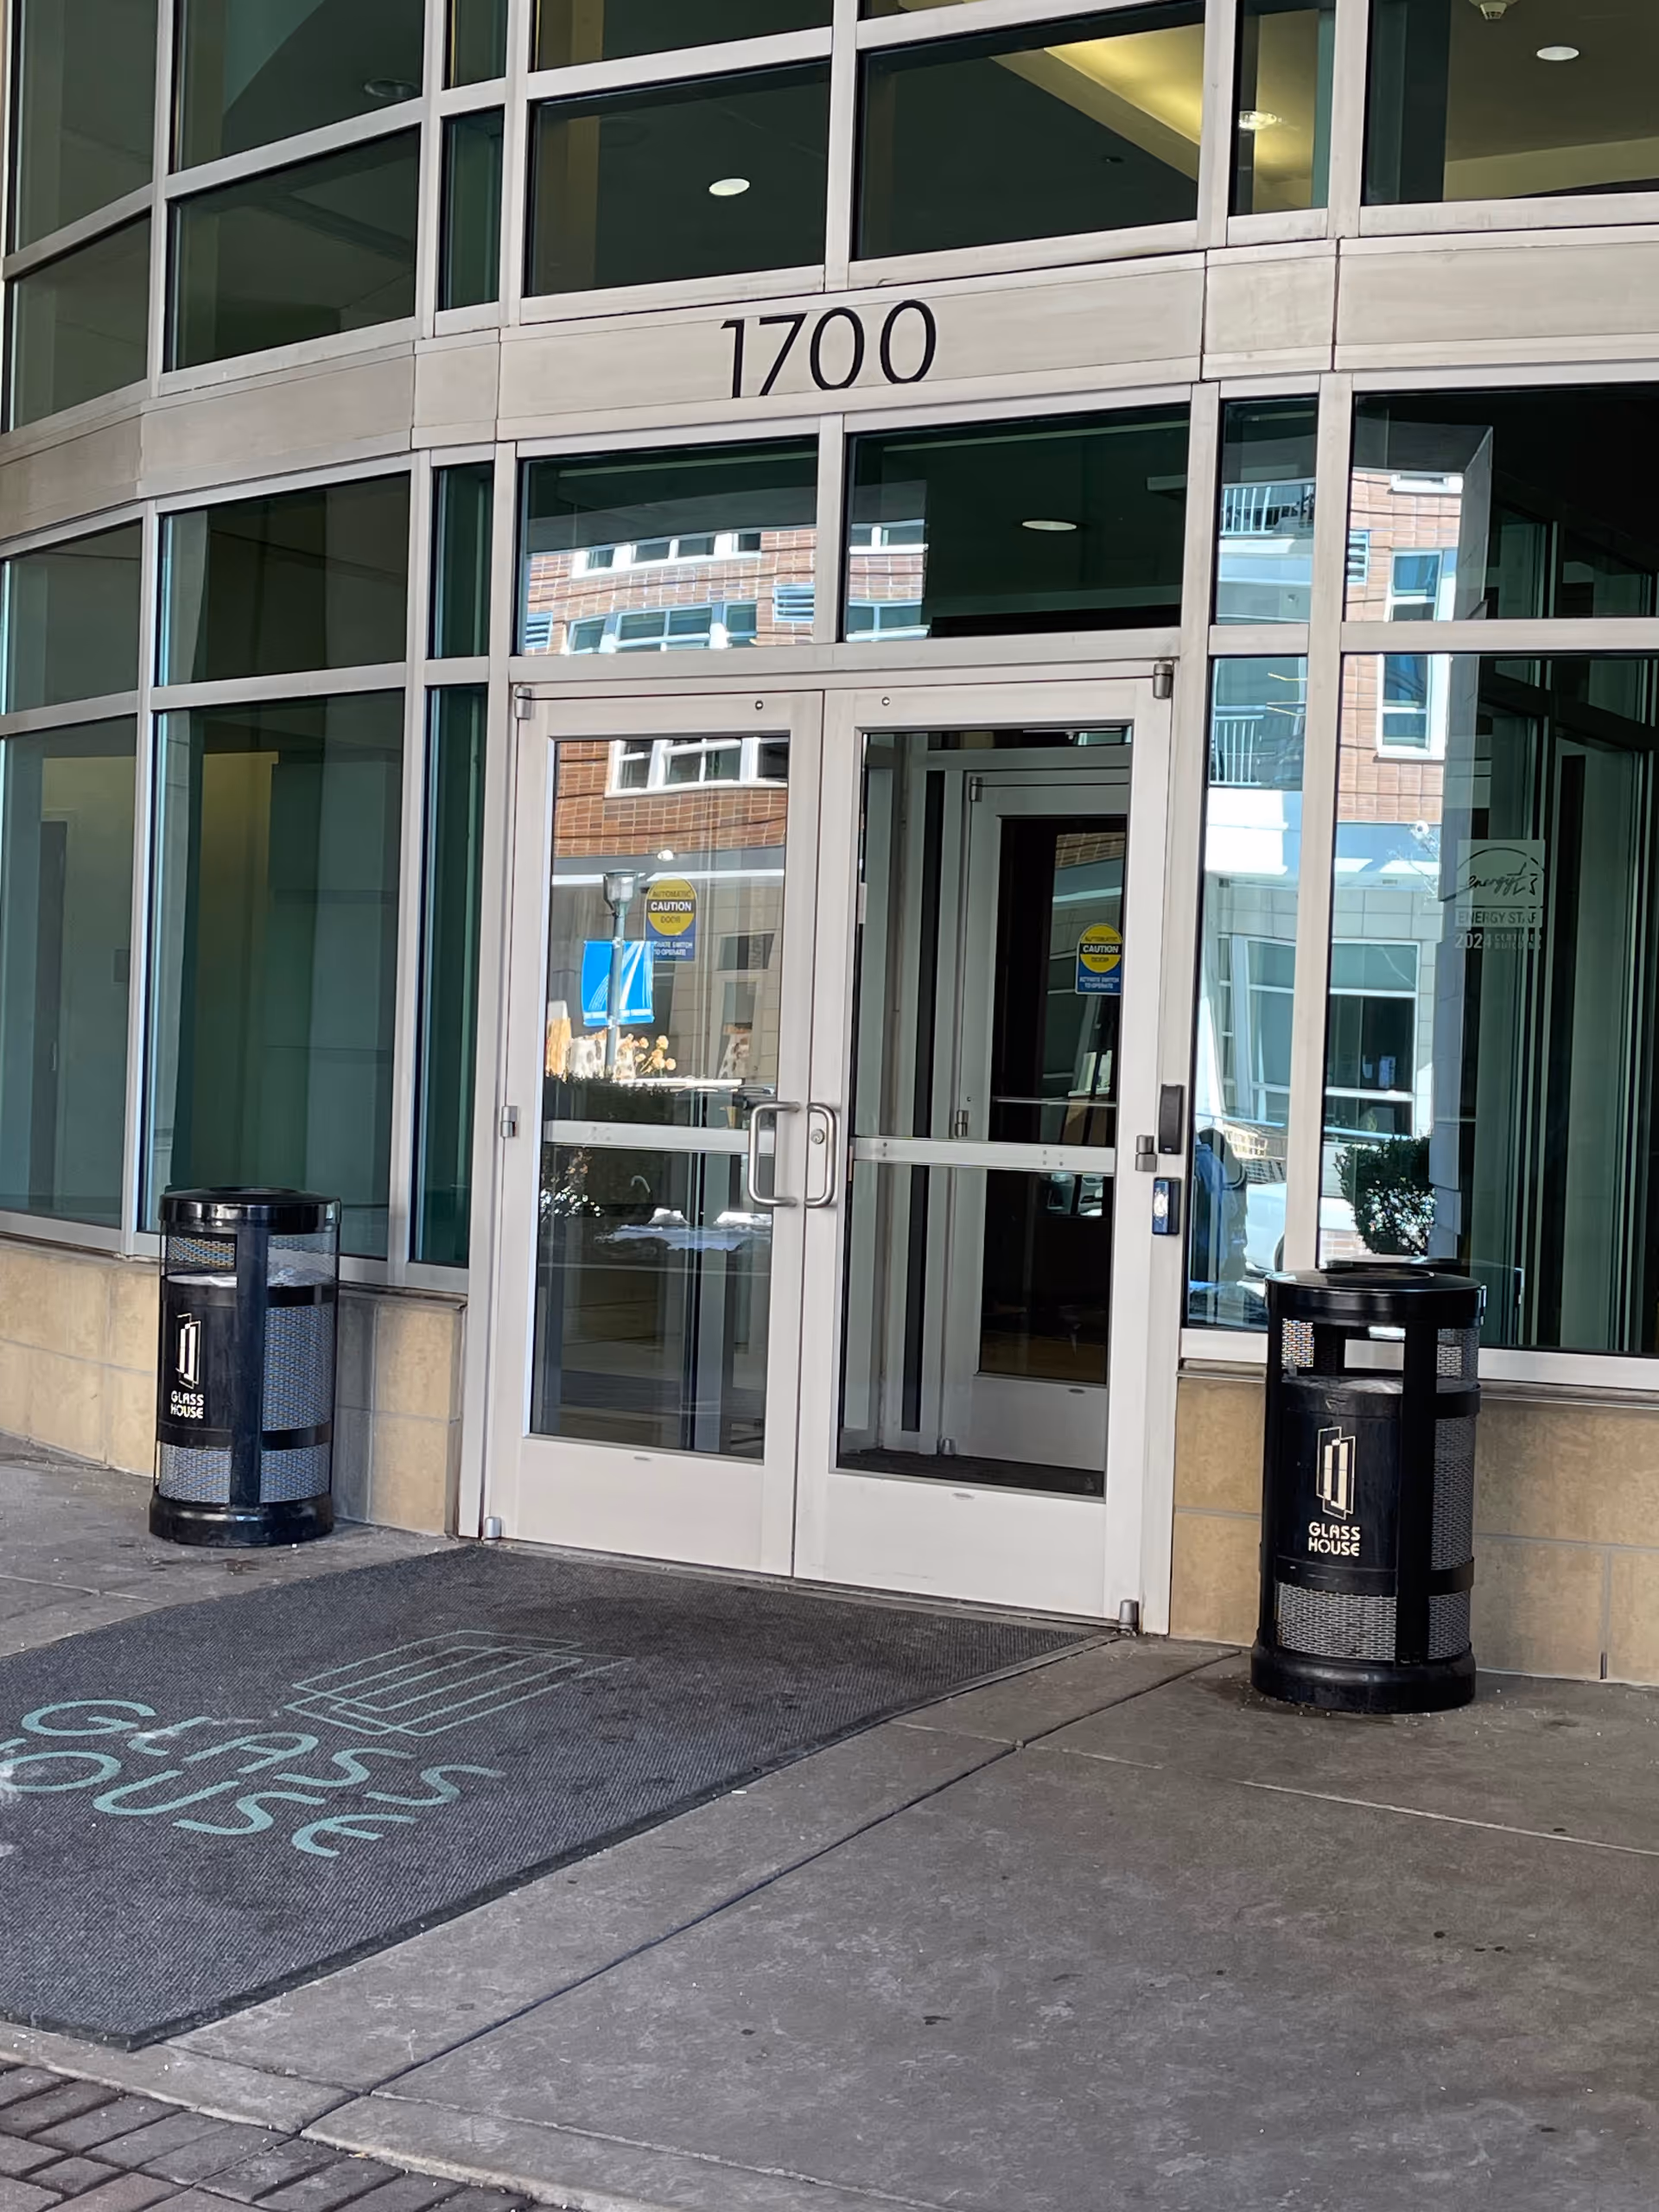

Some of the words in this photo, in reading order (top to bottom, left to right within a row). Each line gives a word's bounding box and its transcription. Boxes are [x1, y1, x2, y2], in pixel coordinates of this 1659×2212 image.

[721, 299, 936, 398] 1700
[651, 901, 691, 911] CAUTION
[1459, 912, 1505, 924] ENERGY
[1083, 944, 1119, 953] CAUTION
[1455, 934, 1491, 949] 2024
[171, 1390, 204, 1407] GLASS
[170, 1403, 203, 1419] HOUSE
[1308, 1522, 1361, 1541] GLASS
[1308, 1537, 1360, 1556] HOUSE
[22, 1700, 506, 1806] GLASS
[0, 1738, 419, 1858] OUSE
